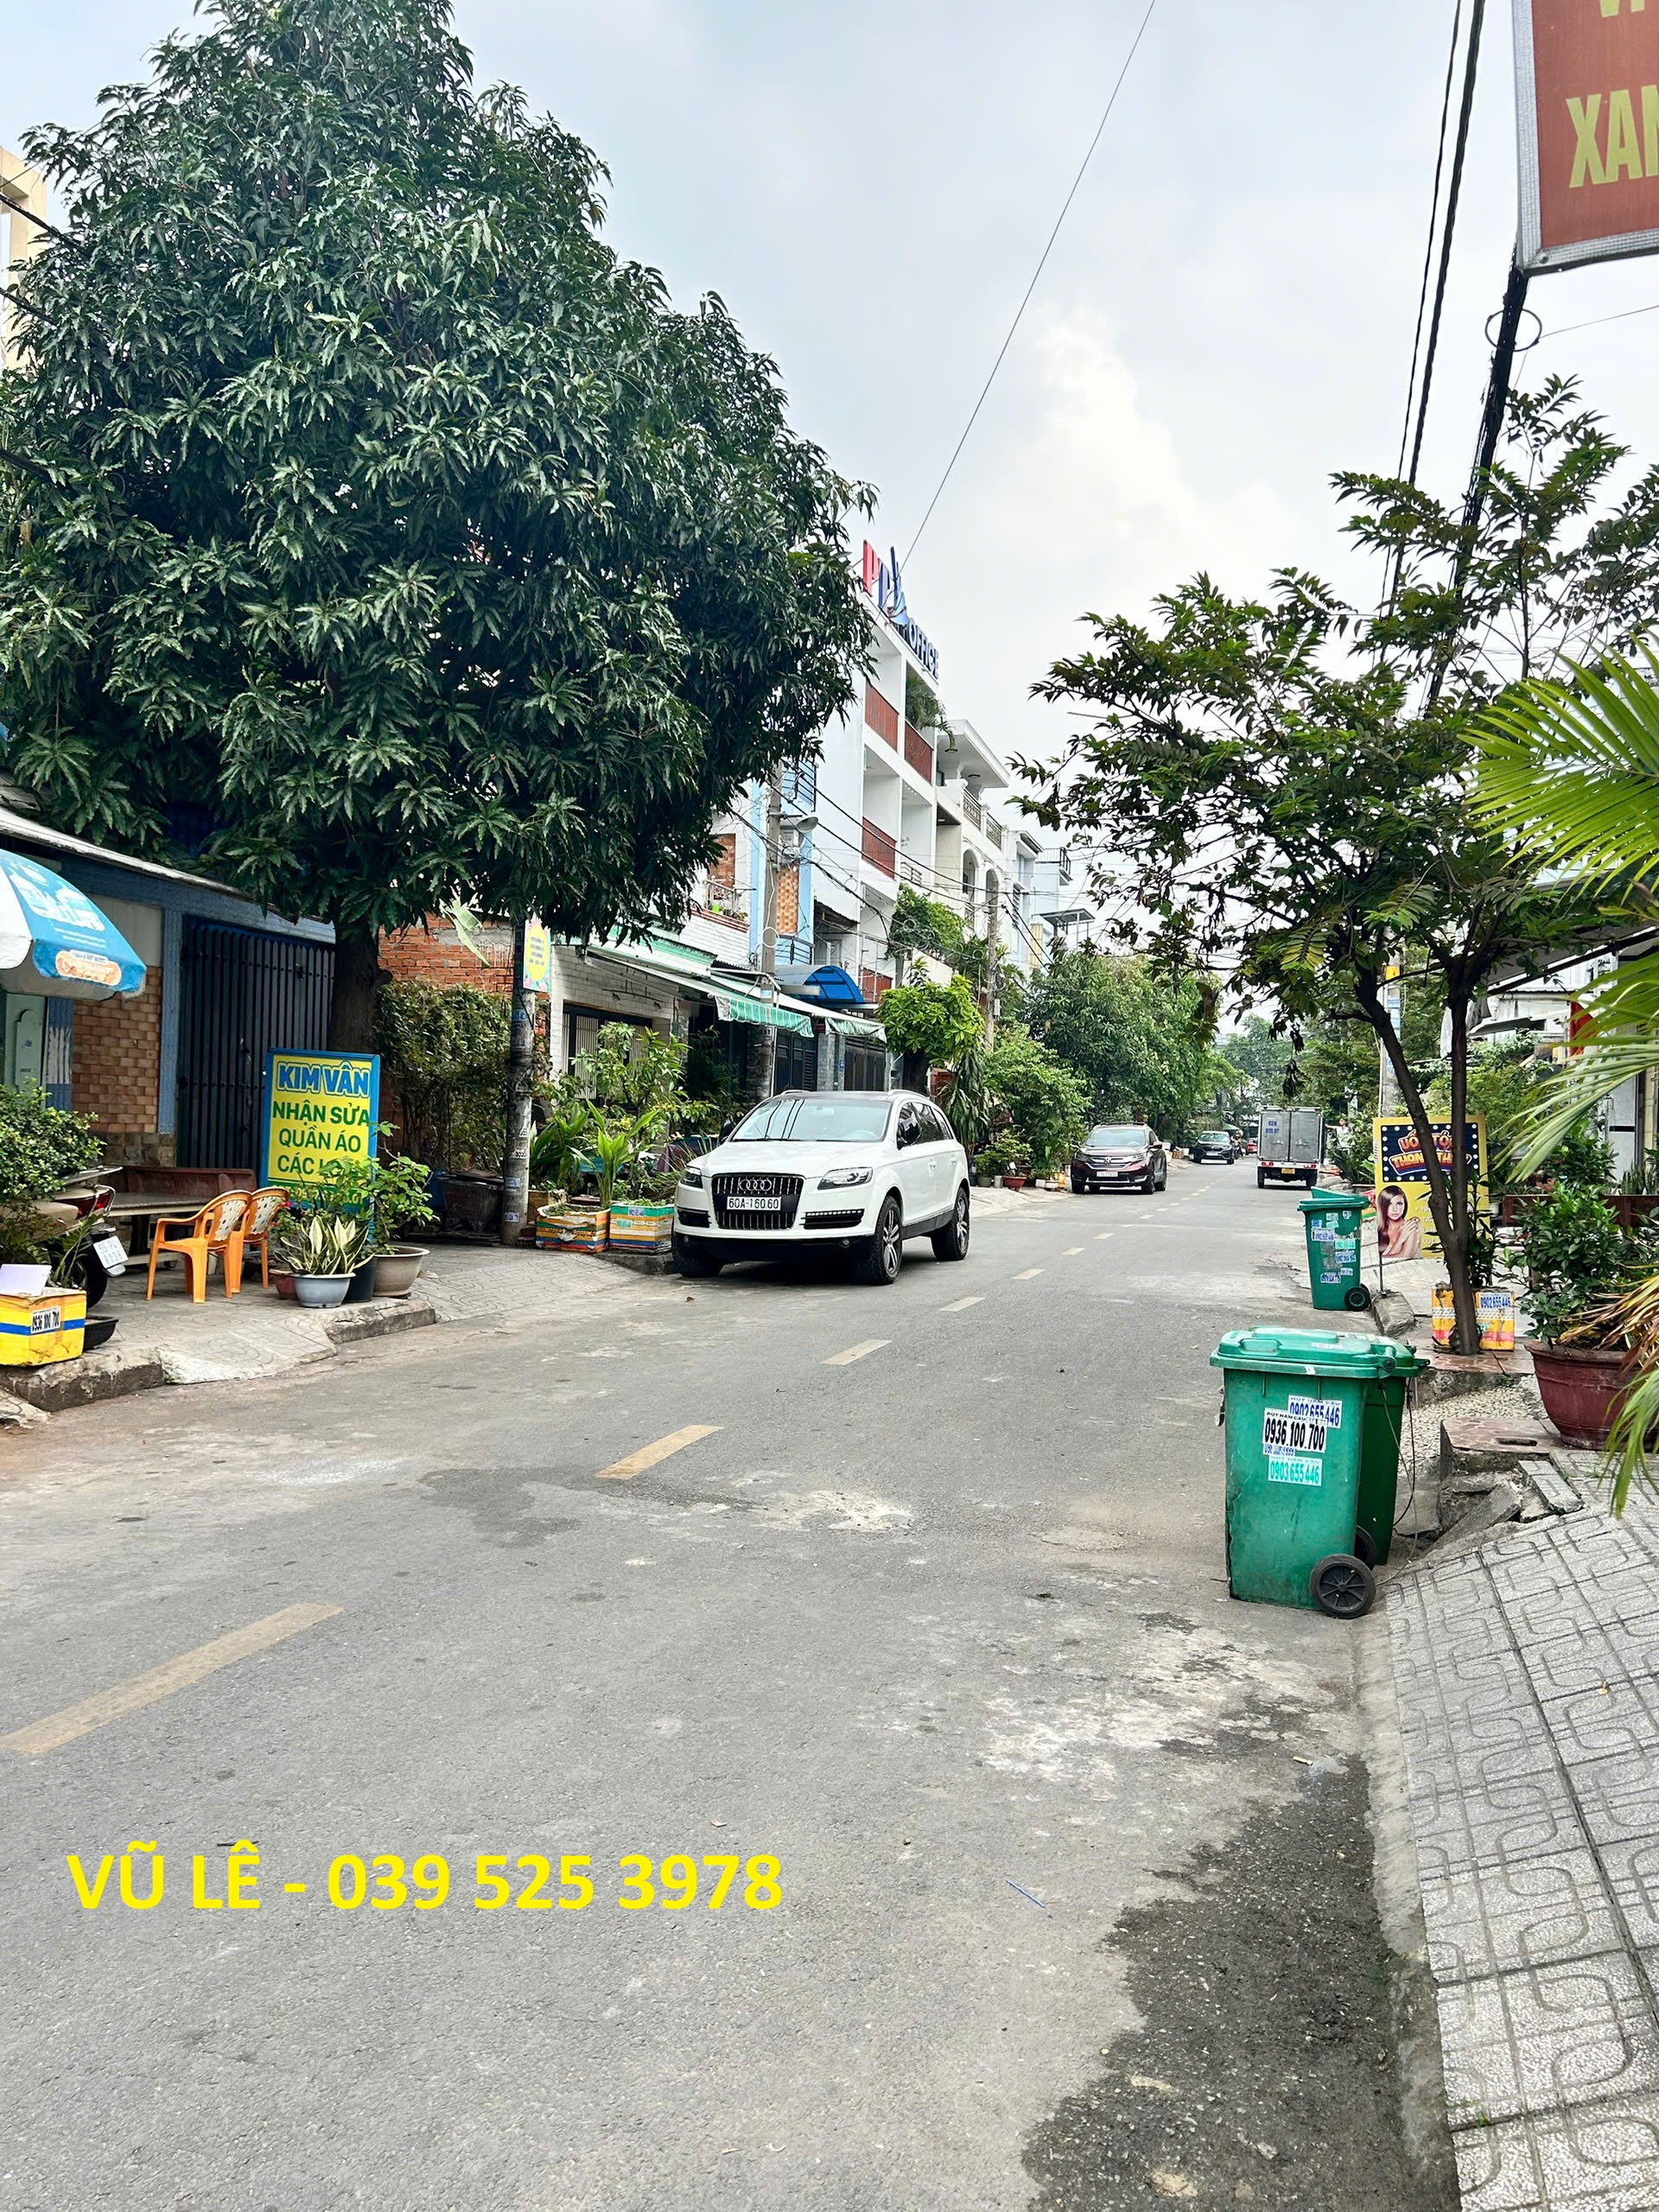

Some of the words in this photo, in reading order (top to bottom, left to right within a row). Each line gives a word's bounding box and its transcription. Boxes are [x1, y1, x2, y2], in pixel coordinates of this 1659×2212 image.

[277, 1061, 321, 1094] KIM
[323, 1060, 371, 1098] VÂN
[273, 1099, 326, 1127] NHẬN
[330, 1103, 370, 1127] SỬA
[279, 1125, 331, 1150] QUẦN
[334, 1130, 361, 1153] ÁO
[277, 1153, 315, 1175] CÁC
[1265, 1417, 1325, 1451] 0936.100.700
